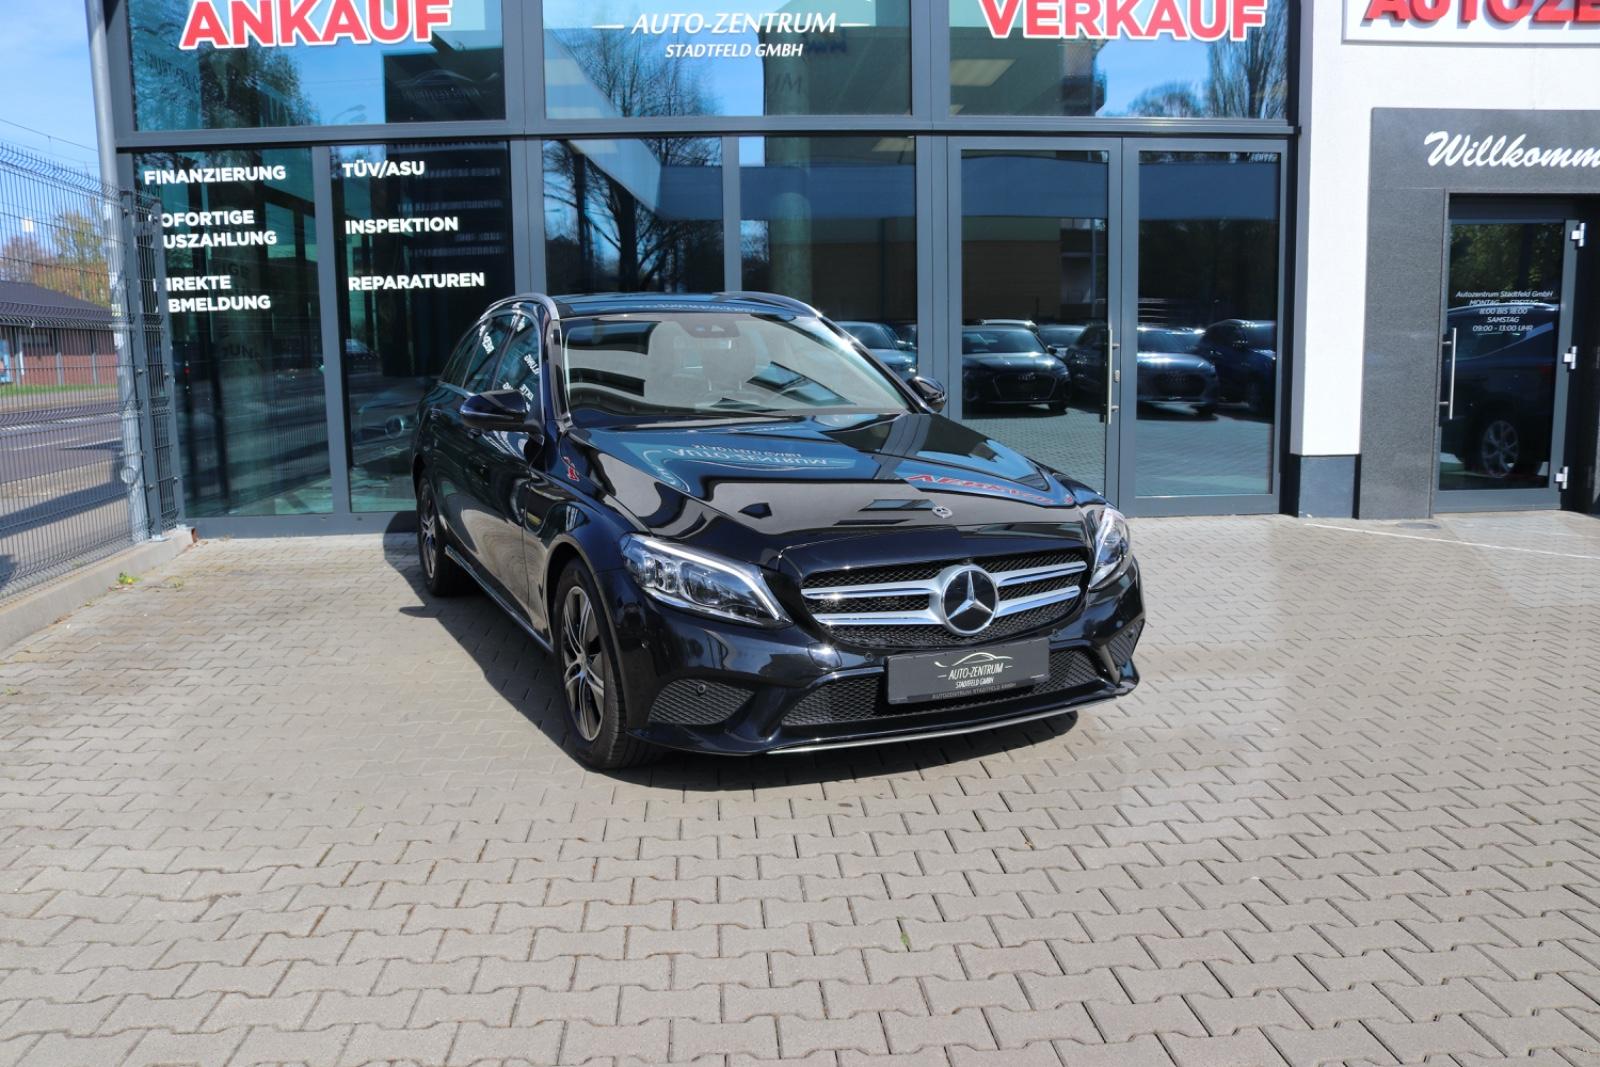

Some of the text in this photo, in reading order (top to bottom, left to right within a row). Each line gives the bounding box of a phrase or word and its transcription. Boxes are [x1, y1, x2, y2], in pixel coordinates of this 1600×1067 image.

[179, 0, 453, 49] ANKAUF
[631, 12, 837, 35] AUTO-ZENTRUM
[980, 0, 1267, 41] VERKAUF
[665, 43, 804, 58] STADTFELD GMBH
[1424, 131, 1600, 168] Willkomm
[144, 165, 287, 185] FINANZIERUNG
[342, 160, 425, 179] TÜV/ASU
[148, 210, 255, 228] OFORTIGE
[345, 216, 459, 235] INSPEKTION
[161, 230, 278, 249] USZAHLUNG
[153, 275, 232, 292] IREKTE
[348, 272, 485, 291] REPARATUREN
[1456, 290, 1498, 298] Autozentrum
[155, 295, 272, 313] BMELDUNG
[948, 662, 1004, 680] AUTO-ZENTRUM
